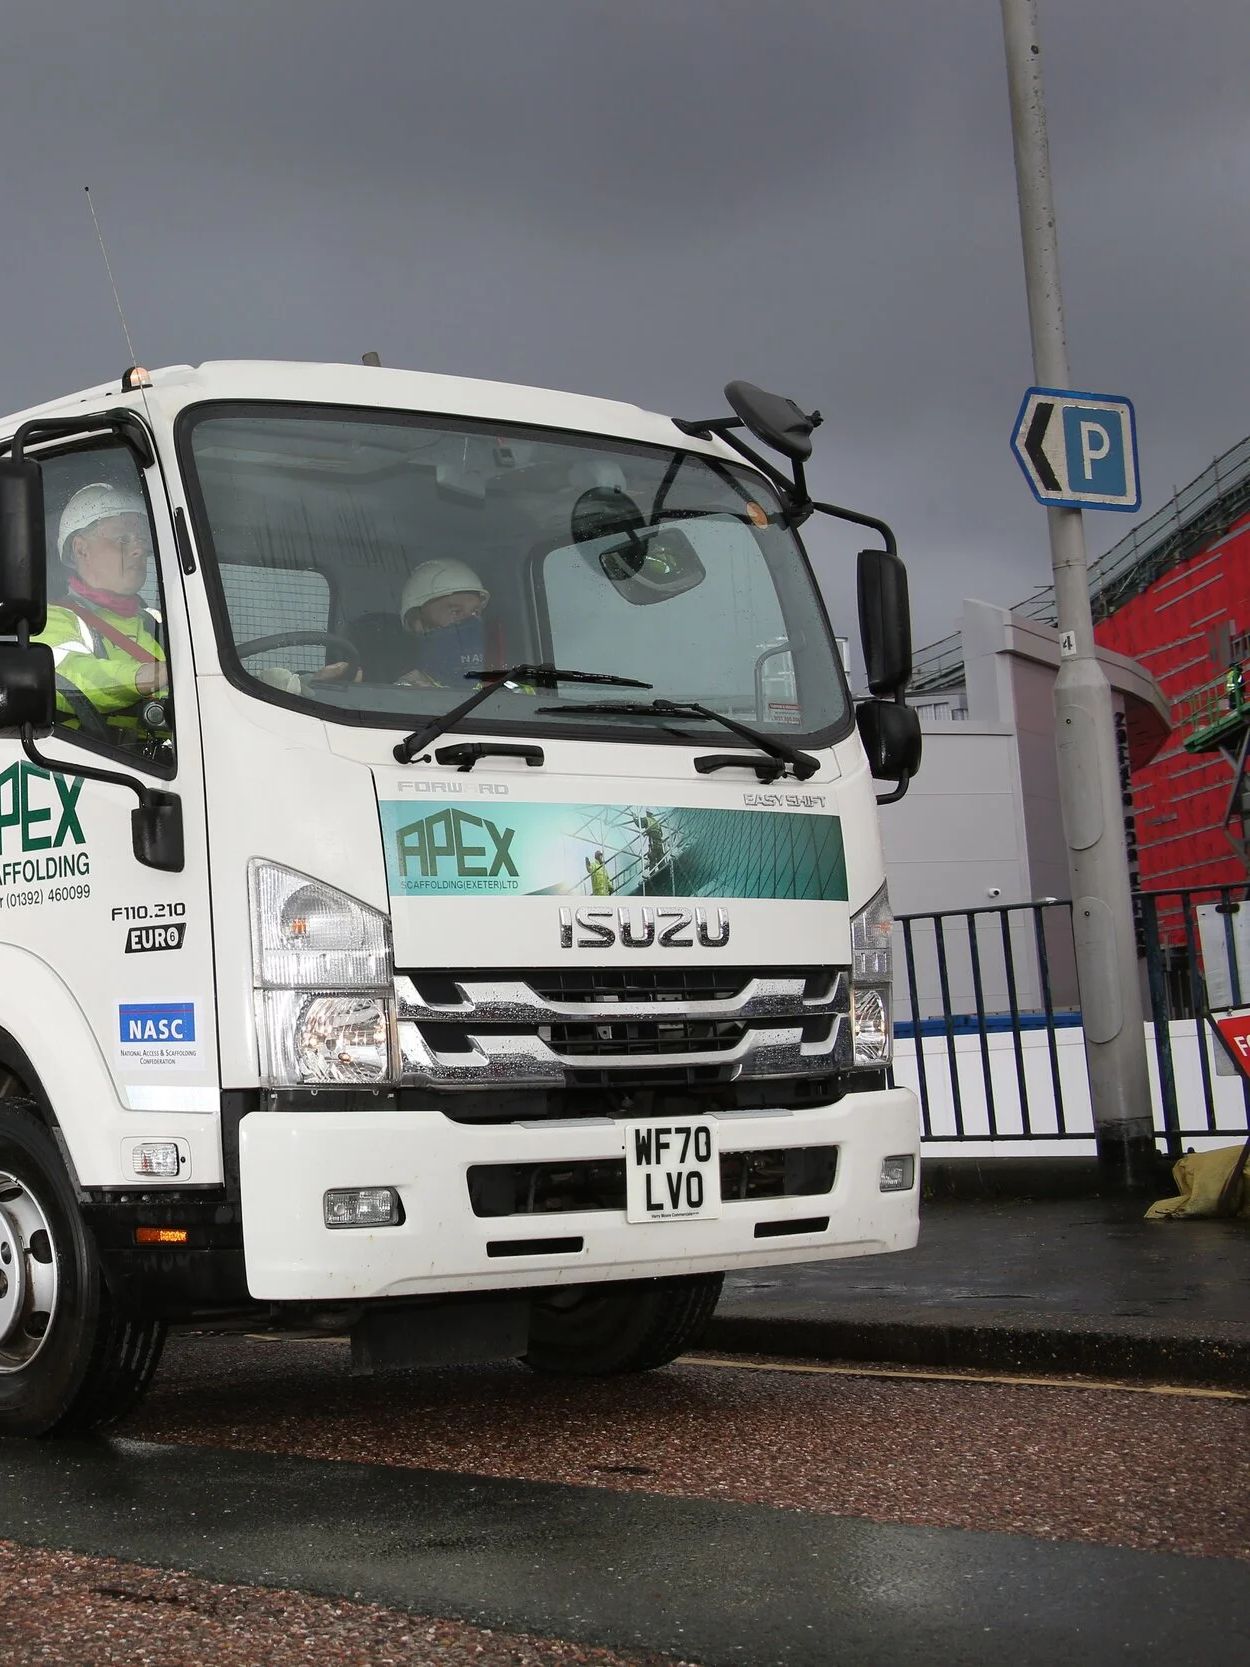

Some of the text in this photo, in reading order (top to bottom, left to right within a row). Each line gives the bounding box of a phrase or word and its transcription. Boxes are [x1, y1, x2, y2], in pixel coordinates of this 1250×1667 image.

[1080, 421, 1110, 480] P
[397, 781, 510, 795] FORWRD
[743, 793, 826, 808] EASY SHIFT
[396, 807, 520, 877] APEX
[7, 889, 44, 909] (01392)
[48, 884, 91, 902] 460099
[111, 902, 186, 921] F110.210
[559, 906, 731, 948] ISUZU
[129, 1019, 183, 1039] NASC
[635, 1126, 711, 1166] WF70
[646, 1171, 703, 1211] LVO
